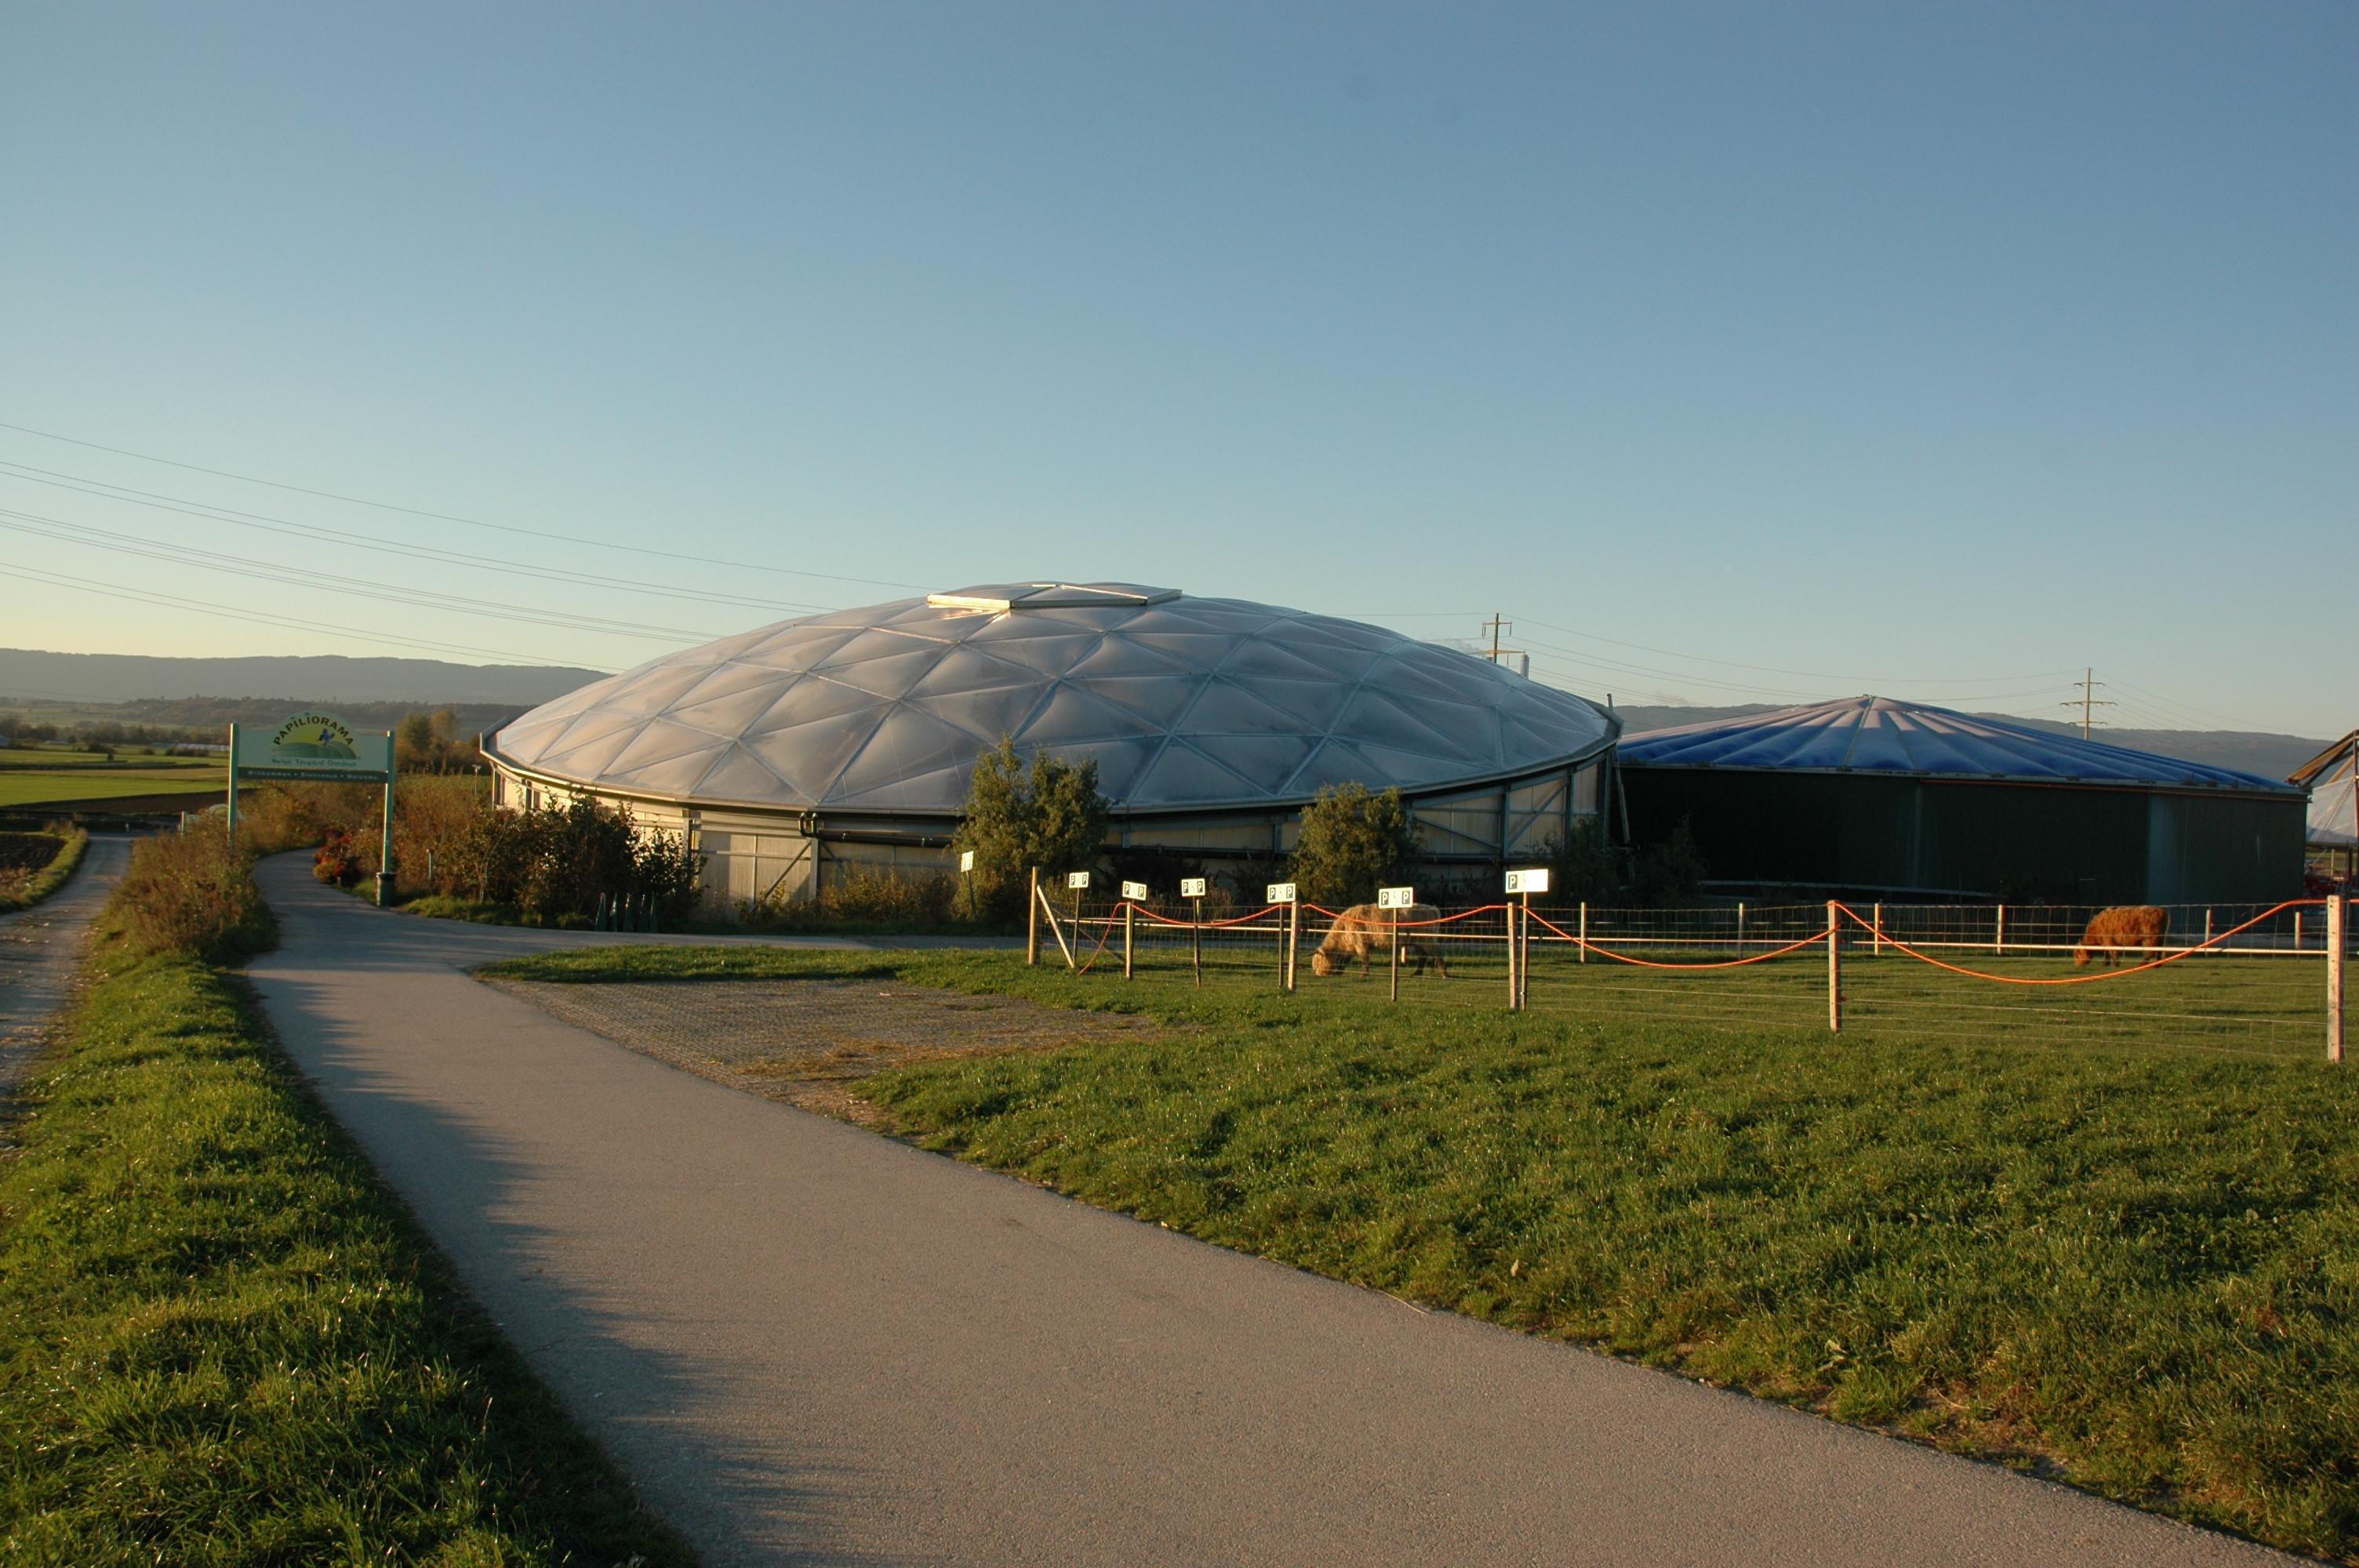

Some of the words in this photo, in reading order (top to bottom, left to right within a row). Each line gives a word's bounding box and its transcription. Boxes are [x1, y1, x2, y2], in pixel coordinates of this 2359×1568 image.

[273, 715, 354, 745] PAPILIORAMA
[1509, 876, 1516, 888] P
[1382, 892, 1388, 905] P
[1403, 891, 1409, 904] P
